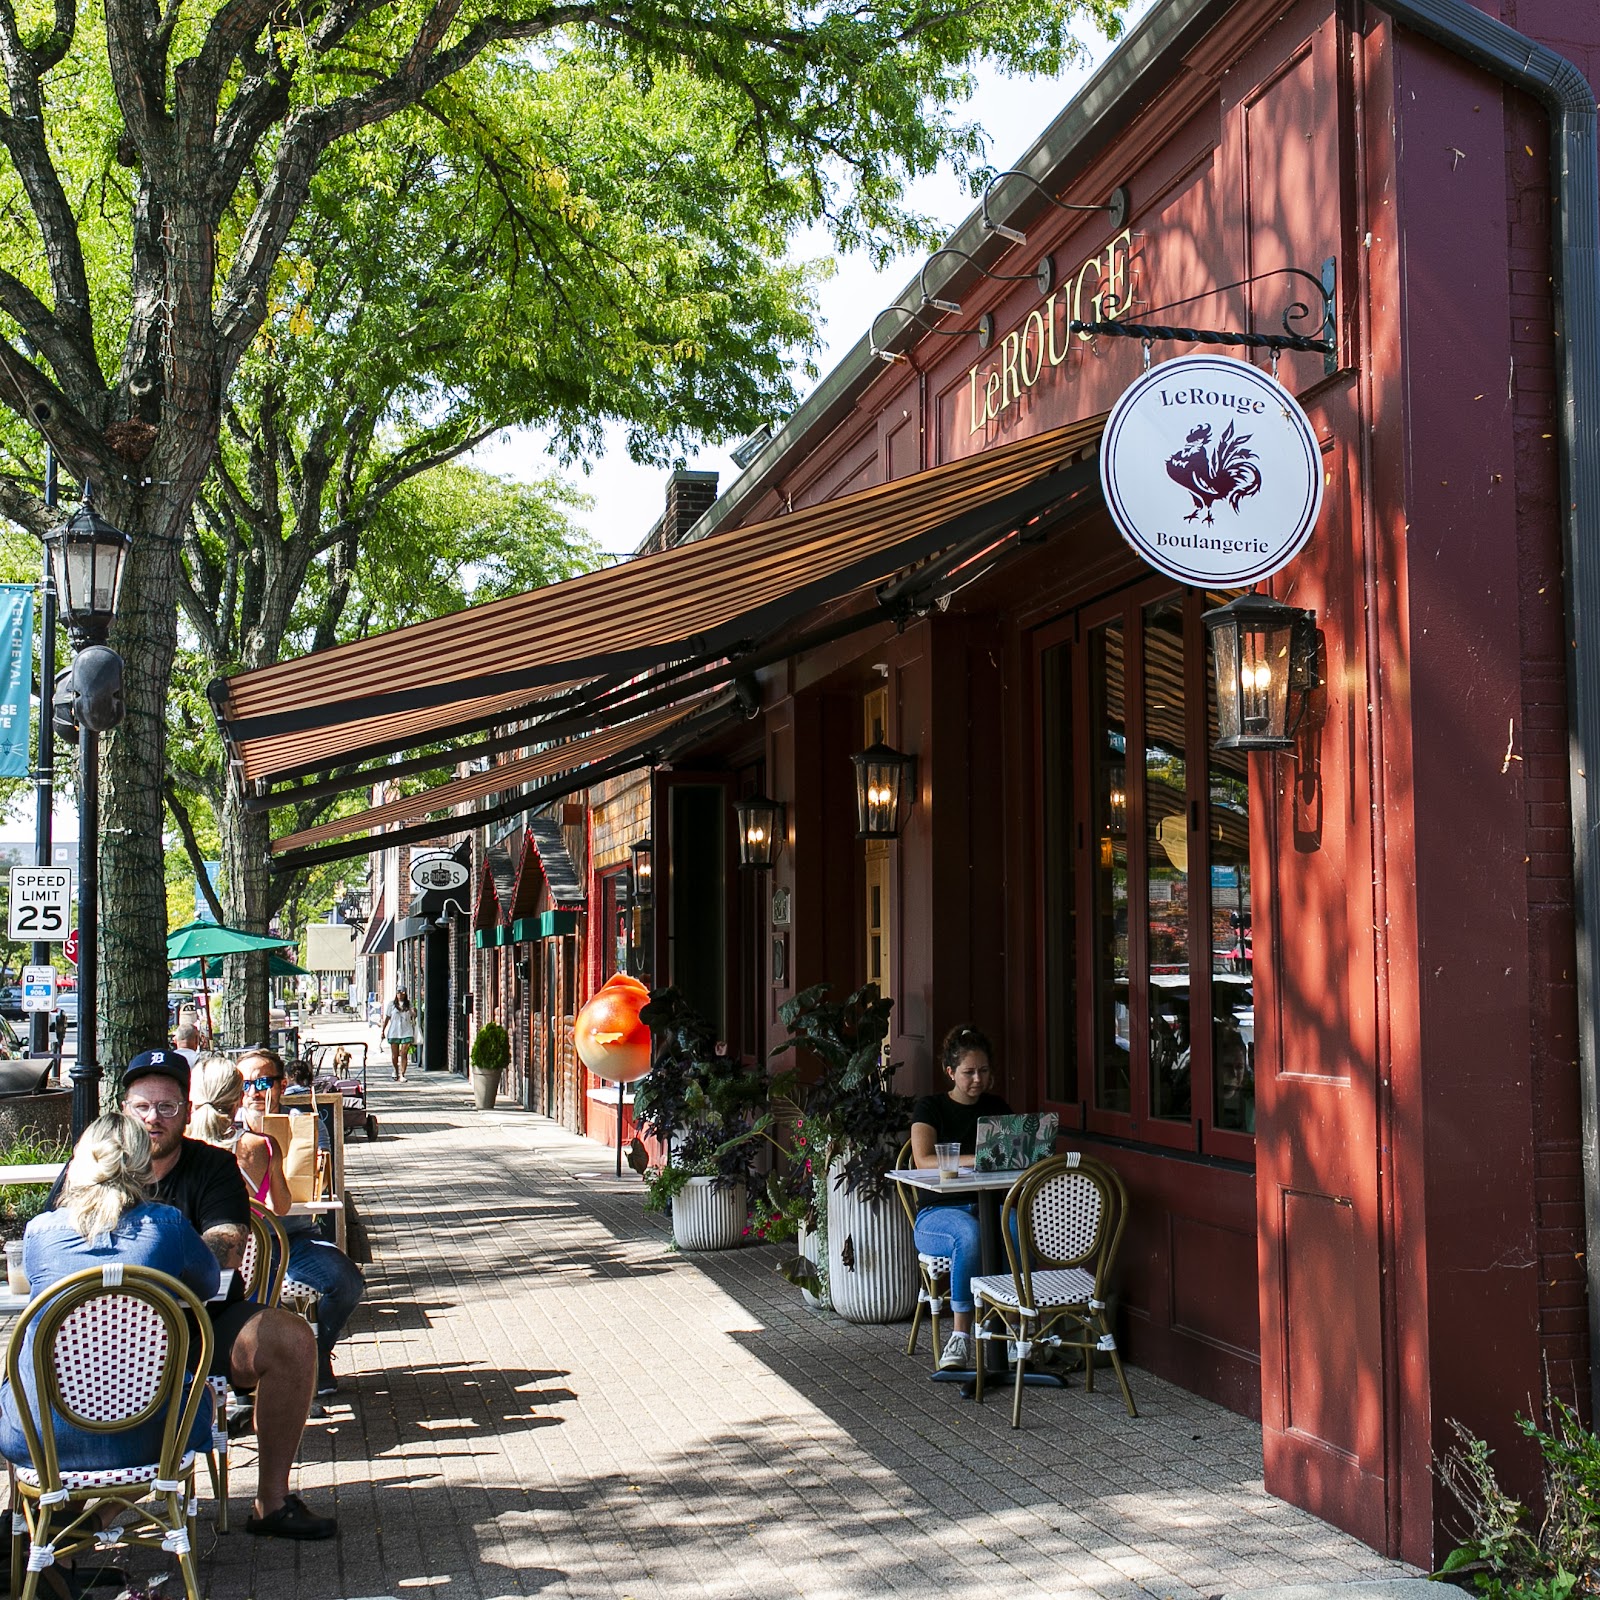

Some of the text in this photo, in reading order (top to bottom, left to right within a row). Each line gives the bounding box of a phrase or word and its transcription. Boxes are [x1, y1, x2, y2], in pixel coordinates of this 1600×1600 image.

[969, 228, 1134, 435] LeROUGE
[1160, 388, 1266, 414] LeRouge
[1156, 532, 1269, 555] Boulangerie
[10, 597, 23, 689] KERCHEVAL
[17, 876, 66, 887] SPEED
[22, 891, 60, 901] LIMIT
[17, 905, 63, 931] 25
